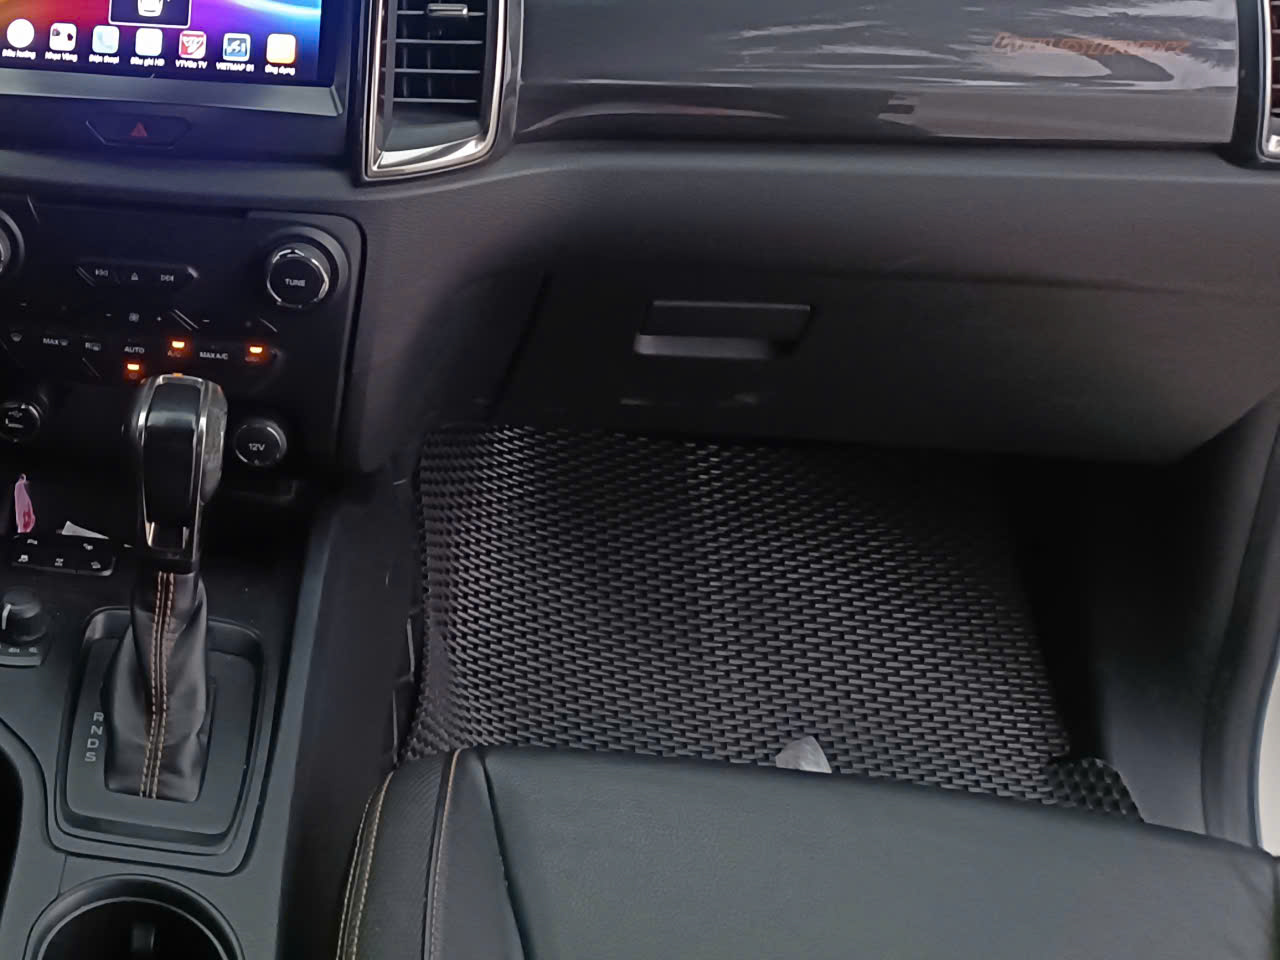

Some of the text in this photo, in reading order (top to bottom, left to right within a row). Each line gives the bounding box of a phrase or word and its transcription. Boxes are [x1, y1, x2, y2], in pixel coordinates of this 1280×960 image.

[198, 60, 208, 70] TV
[285, 278, 306, 287] TUNE
[124, 346, 145, 354] AUTO
[199, 351, 215, 359] MAX
[248, 443, 265, 451] 12V
[93, 711, 104, 722] R
[90, 725, 103, 736] N
[87, 738, 100, 748] D
[84, 751, 97, 762] S
